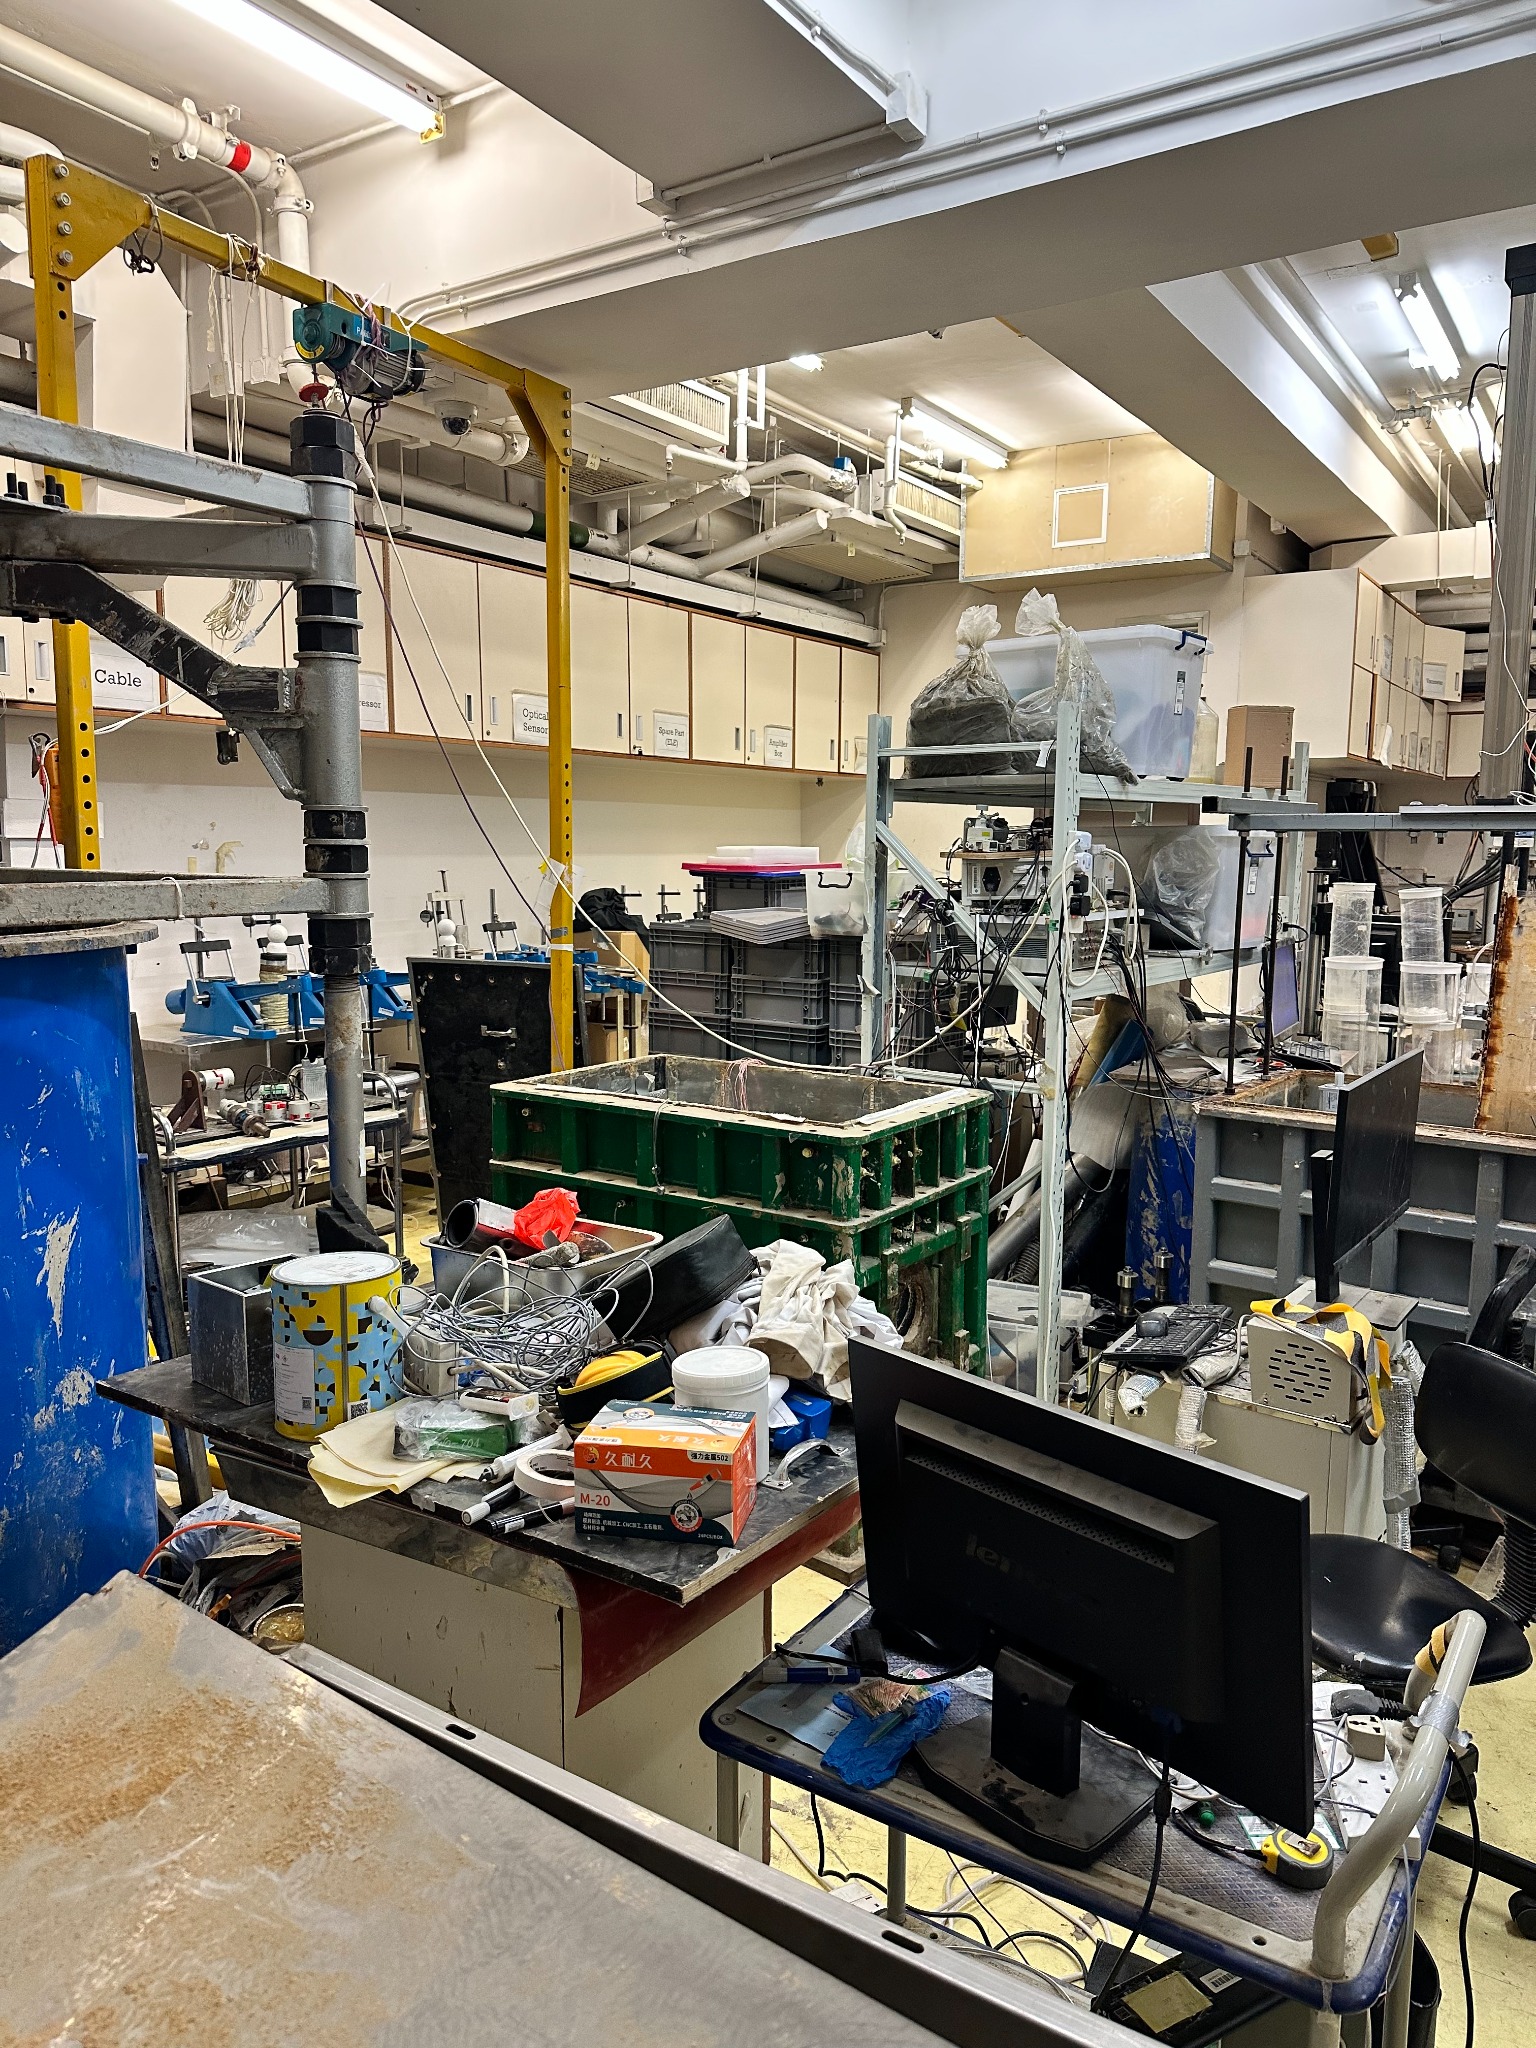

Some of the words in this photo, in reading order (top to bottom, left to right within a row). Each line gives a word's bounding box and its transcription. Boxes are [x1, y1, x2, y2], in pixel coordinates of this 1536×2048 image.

[94, 669, 142, 688] Cable
[359, 700, 382, 709] ressor
[522, 708, 549, 721] Optical
[522, 722, 549, 735] Sensor
[461, 1438, 480, 1449] 704
[604, 1451, 653, 1470] 久耐久
[691, 1452, 729, 1462] 强力金属502
[580, 1492, 611, 1507] M-20
